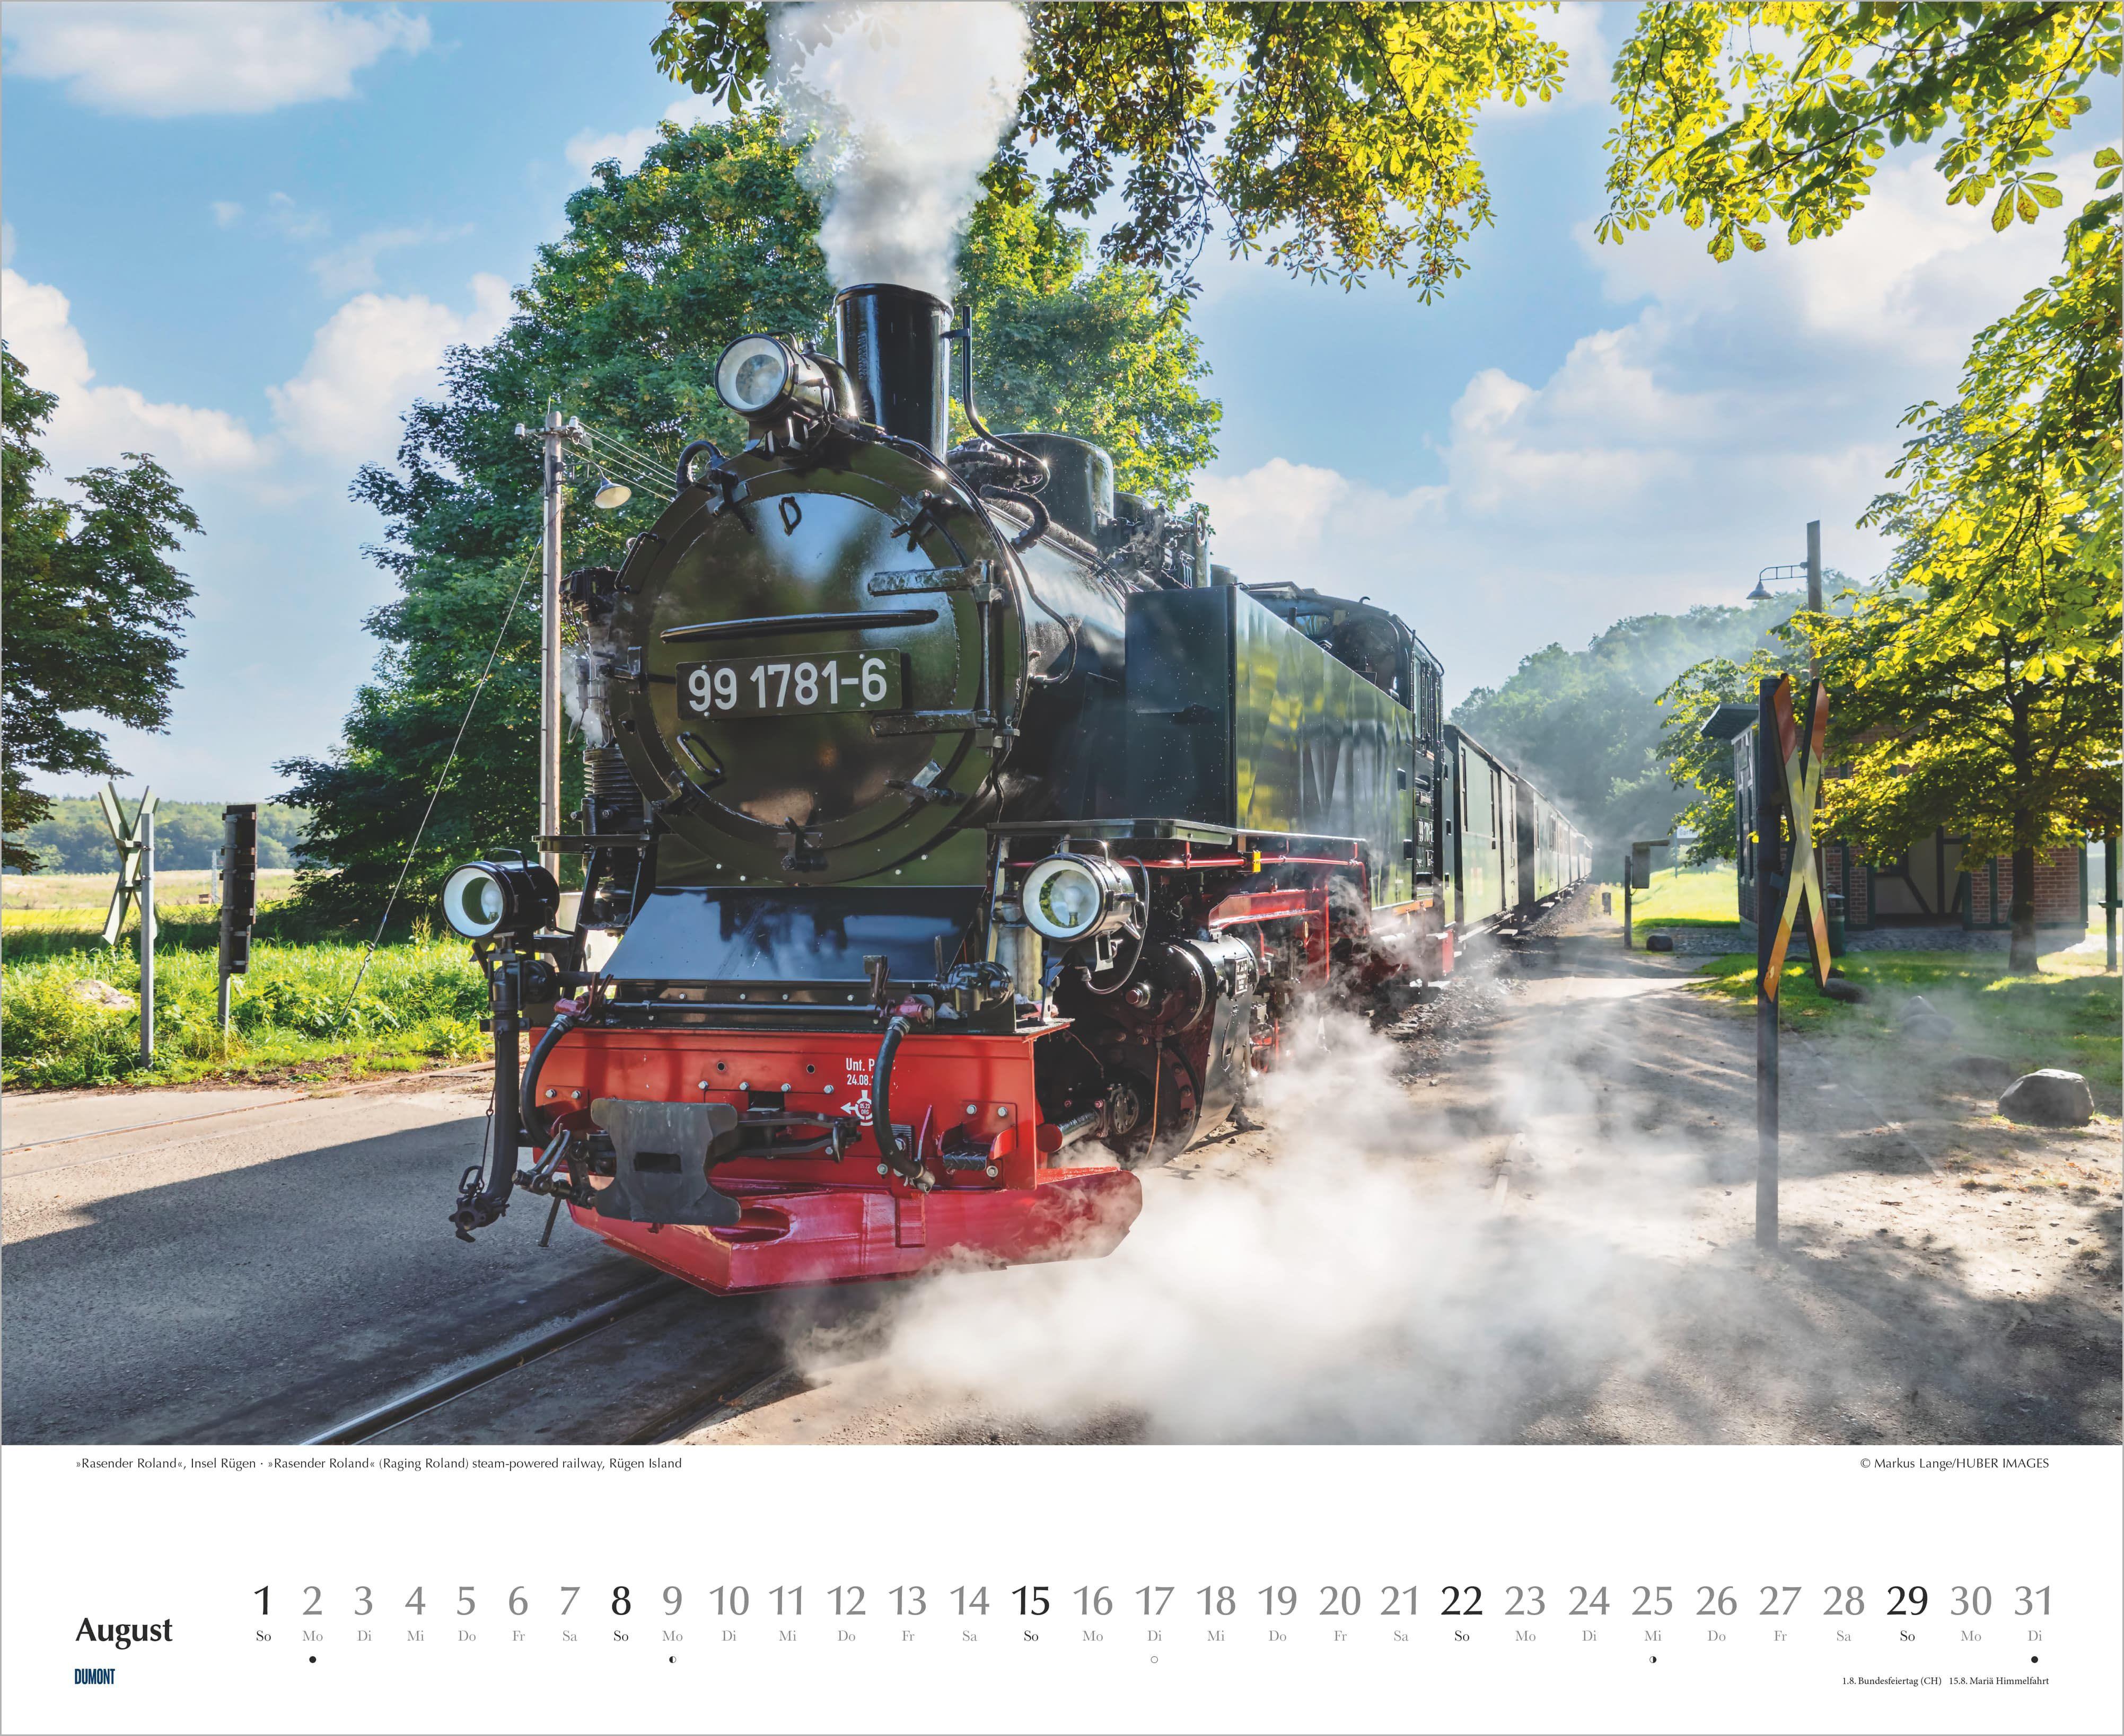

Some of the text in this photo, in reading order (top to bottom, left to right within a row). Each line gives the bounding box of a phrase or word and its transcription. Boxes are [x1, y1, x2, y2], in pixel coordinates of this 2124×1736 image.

[689, 658, 887, 711] 99 1781-6
[846, 1058, 865, 1071] Unt.
